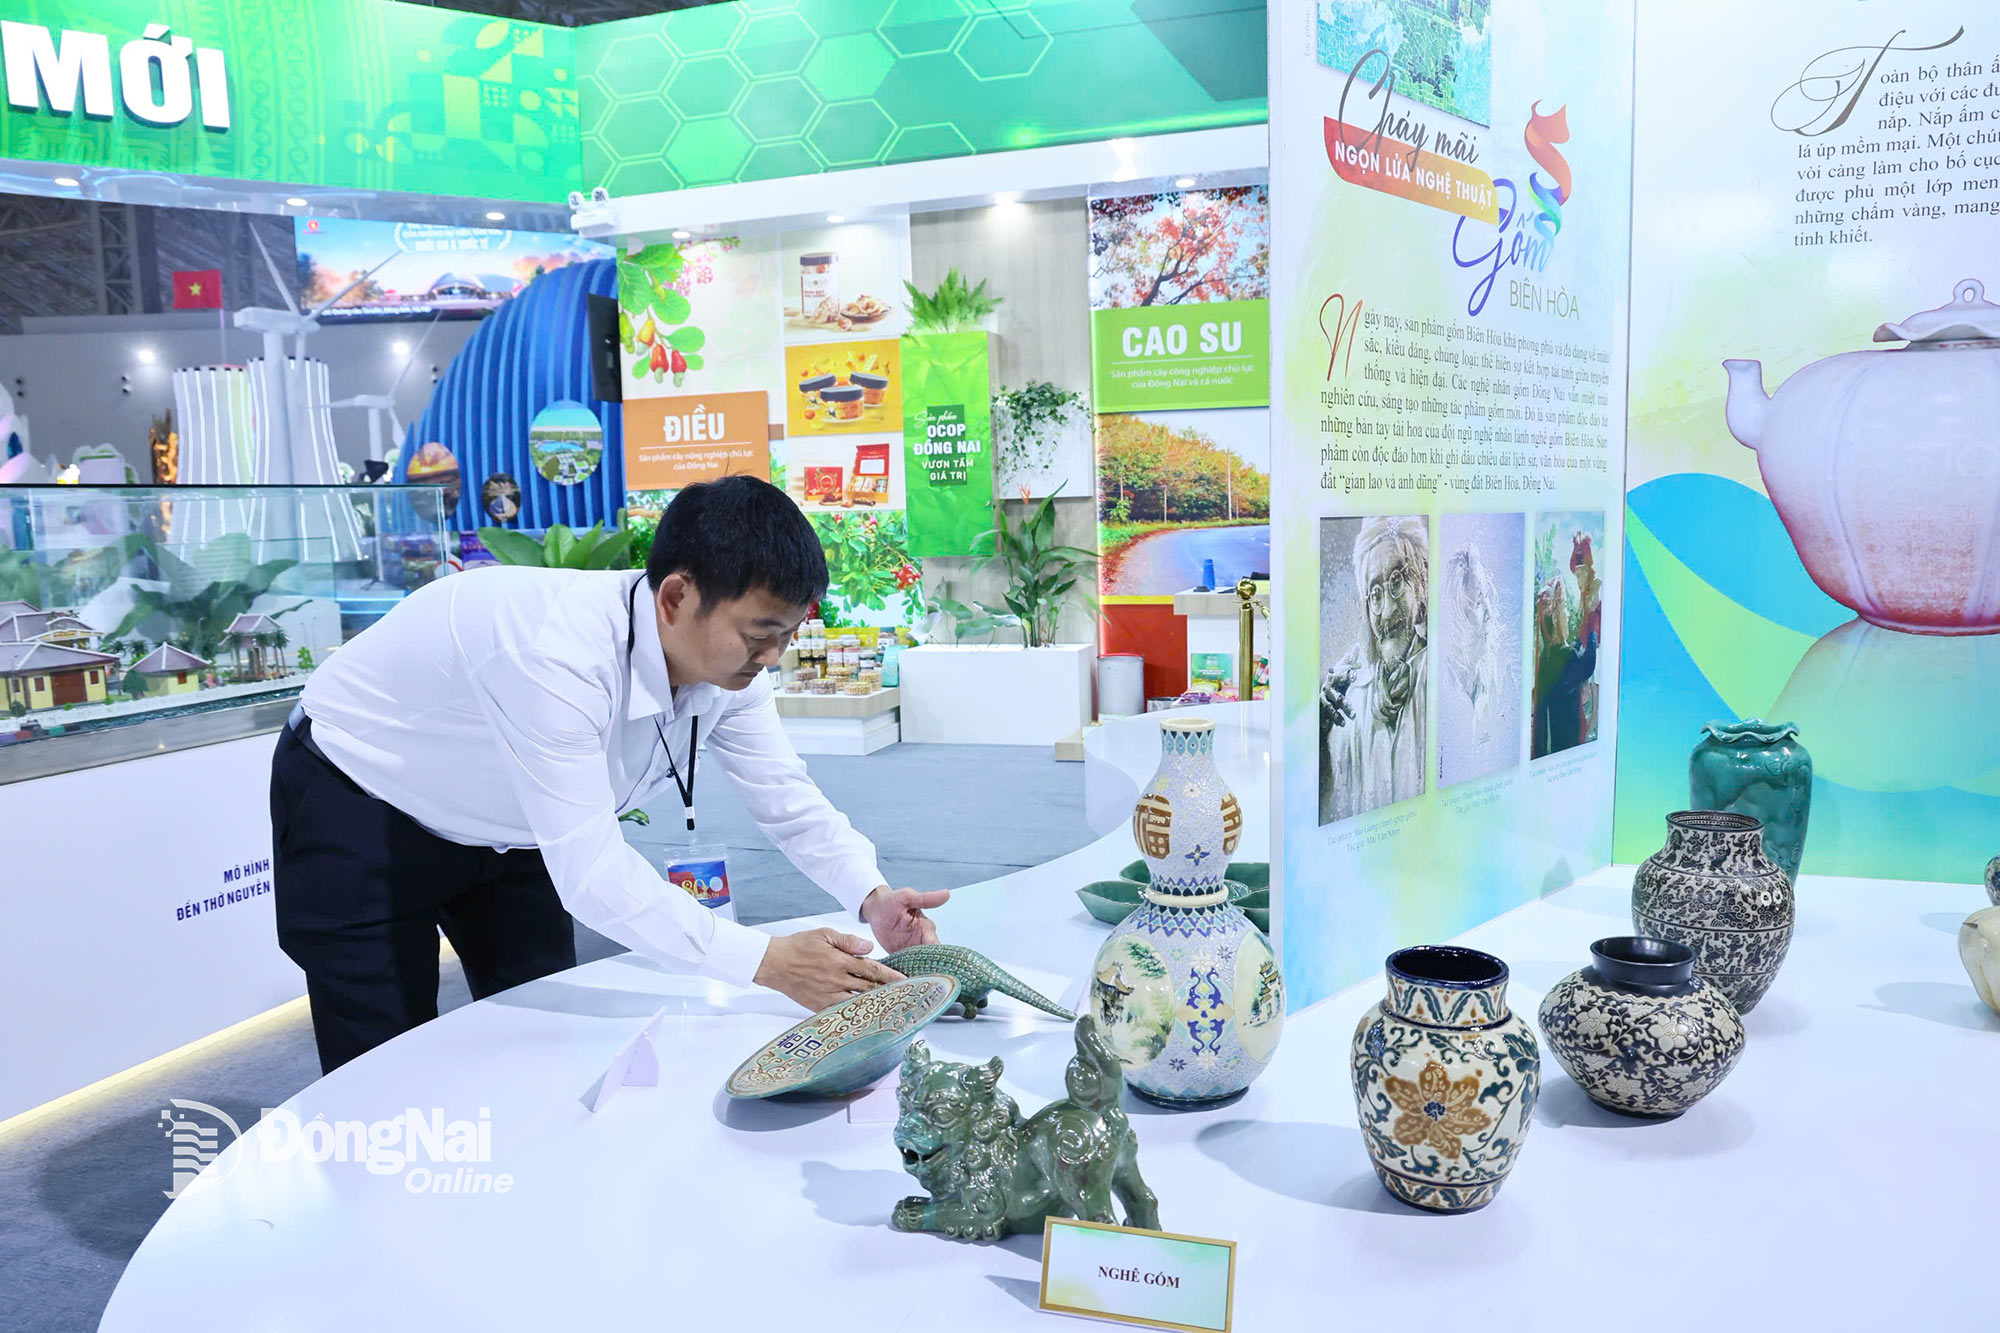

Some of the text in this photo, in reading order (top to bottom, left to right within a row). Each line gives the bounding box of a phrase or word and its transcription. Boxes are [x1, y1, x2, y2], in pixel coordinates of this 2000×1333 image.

[1, 20, 230, 130] MỚI
[1918, 65, 1939, 83] bộ
[1946, 61, 1982, 78] thân
[1879, 92, 1914, 109] điệu
[1919, 87, 1946, 102] với
[1950, 85, 1978, 101] các
[1338, 48, 1480, 173] Cháy mãi
[1877, 110, 1912, 132] nắp.
[1919, 108, 1953, 128] Nắp
[1959, 104, 1984, 122] ấm
[1798, 144, 1812, 159] lá
[1816, 143, 1836, 160] úp
[1841, 136, 1881, 155] mềm
[1886, 136, 1921, 153] mại.
[1927, 132, 1961, 150] Một
[1333, 140, 1493, 210] NGỌN LỬA NGHỆ THUẬT
[1797, 162, 1821, 180] vòi
[1828, 165, 1865, 179] càng
[1873, 160, 1902, 175] làm
[1909, 157, 1939, 172] cho
[1946, 150, 1967, 169] bố
[1795, 178, 1999, 204] được phủ một lớp men
[1795, 201, 2000, 226] những chấm vàng, mang
[1794, 225, 1873, 247] tinh khiết.
[1509, 277, 1580, 320] BIÊN HÒA
[1122, 321, 1242, 357] CAO SU
[1320, 387, 1355, 409] nghiên
[1358, 390, 1379, 409] cứu,
[1381, 392, 1403, 414] sáng
[1405, 396, 1419, 415] tạo
[663, 404, 725, 442] ĐIỀU
[927, 423, 966, 438] OCOP
[1320, 415, 1353, 438] những
[1376, 421, 1390, 440] tay
[1407, 420, 1423, 438] hoa
[913, 438, 981, 456] ĐỒNG NAI
[1320, 440, 1349, 466] phẩm
[1372, 446, 1389, 466] độc
[1430, 448, 1443, 464] khi
[921, 459, 950, 470] VƯƠN
[929, 471, 967, 481] GIÁ TRỊ
[1320, 467, 1337, 489] đất
[1368, 473, 1383, 490] lao
[1398, 473, 1414, 490] anh
[223, 858, 270, 883] MÔ HÌNH
[176, 900, 201, 922] ĐỀN
[203, 891, 225, 912] THỜ
[1098, 1266, 1140, 1283] NGHÊ
